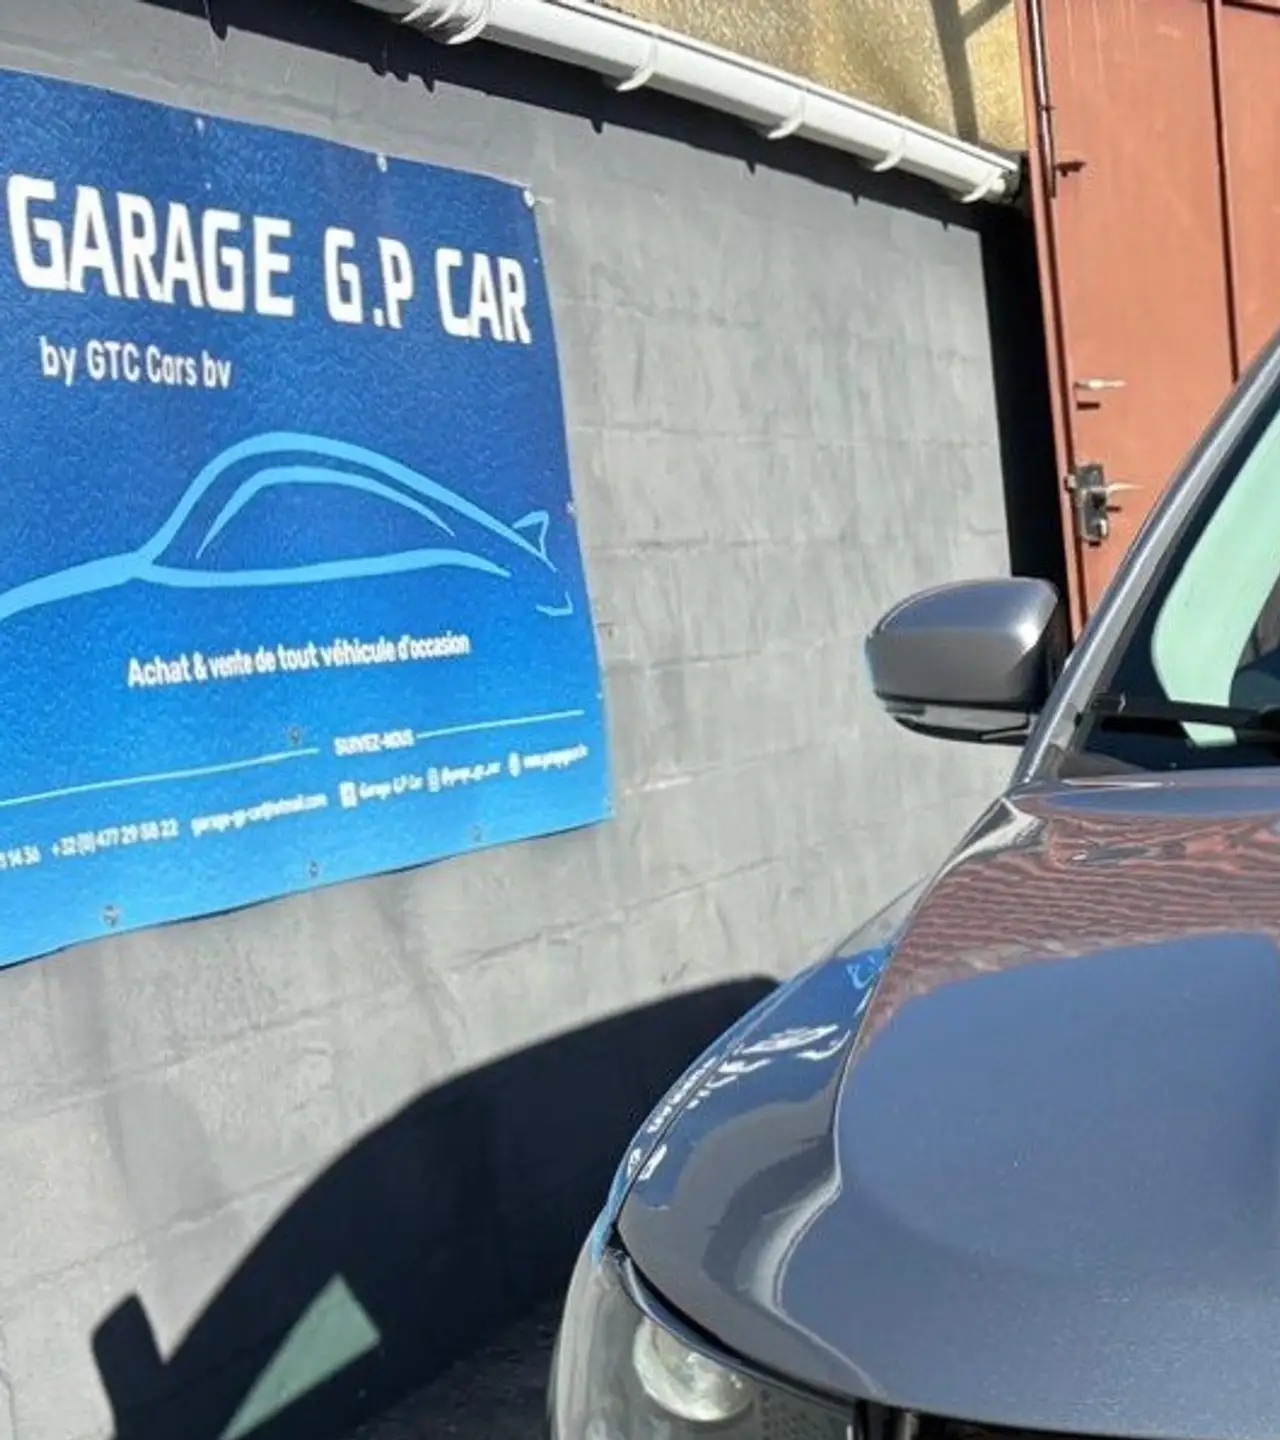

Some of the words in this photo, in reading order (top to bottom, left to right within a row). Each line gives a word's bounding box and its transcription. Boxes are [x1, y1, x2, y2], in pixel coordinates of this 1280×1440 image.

[6, 173, 295, 317] GARAGE
[323, 228, 415, 328] G.P
[435, 247, 532, 344] CAR
[39, 335, 76, 387] by
[86, 339, 140, 382] GTC
[146, 344, 197, 387] Cars
[202, 350, 231, 389] bv
[128, 652, 192, 688] Achat
[193, 651, 208, 682] &
[208, 648, 253, 679] vente
[255, 645, 276, 672] de
[277, 641, 320, 671] tout
[320, 635, 396, 667] véhicule
[398, 630, 471, 661] d'occasion
